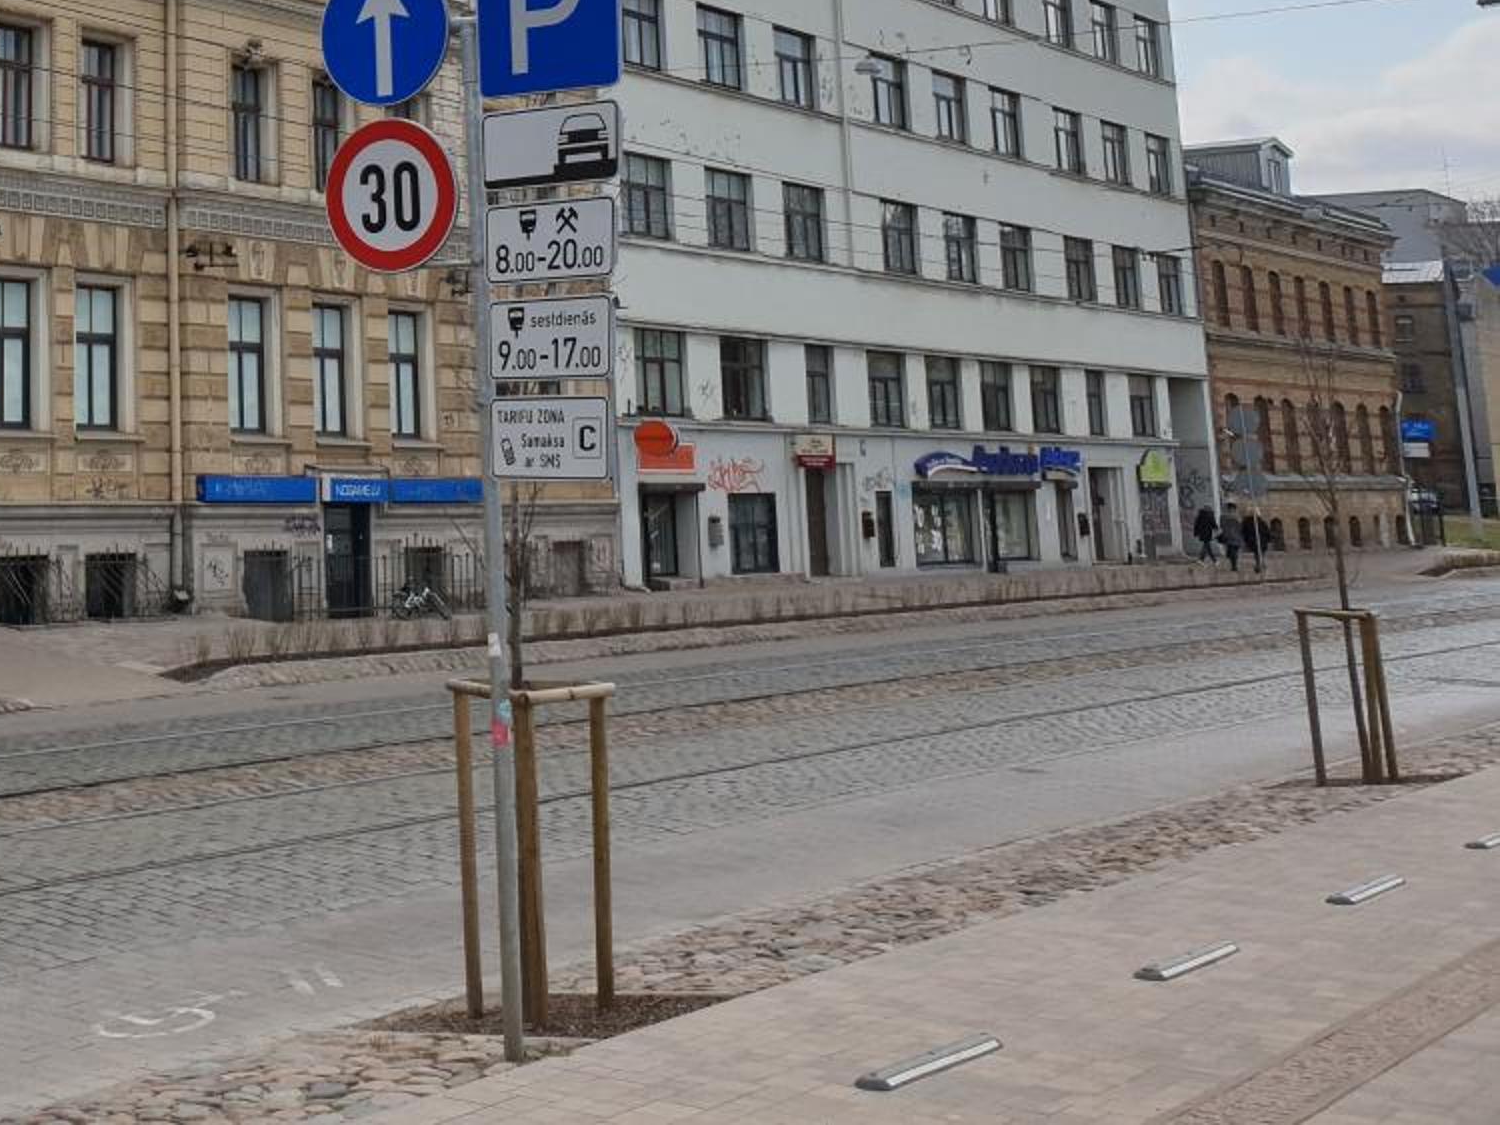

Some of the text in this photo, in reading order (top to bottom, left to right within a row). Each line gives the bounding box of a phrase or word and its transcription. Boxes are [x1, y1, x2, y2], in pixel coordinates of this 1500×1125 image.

[360, 161, 420, 233] 30
[495, 238, 604, 274] 8.00-20.00
[498, 336, 601, 371] 9.00-17.00
[579, 425, 597, 452] C
